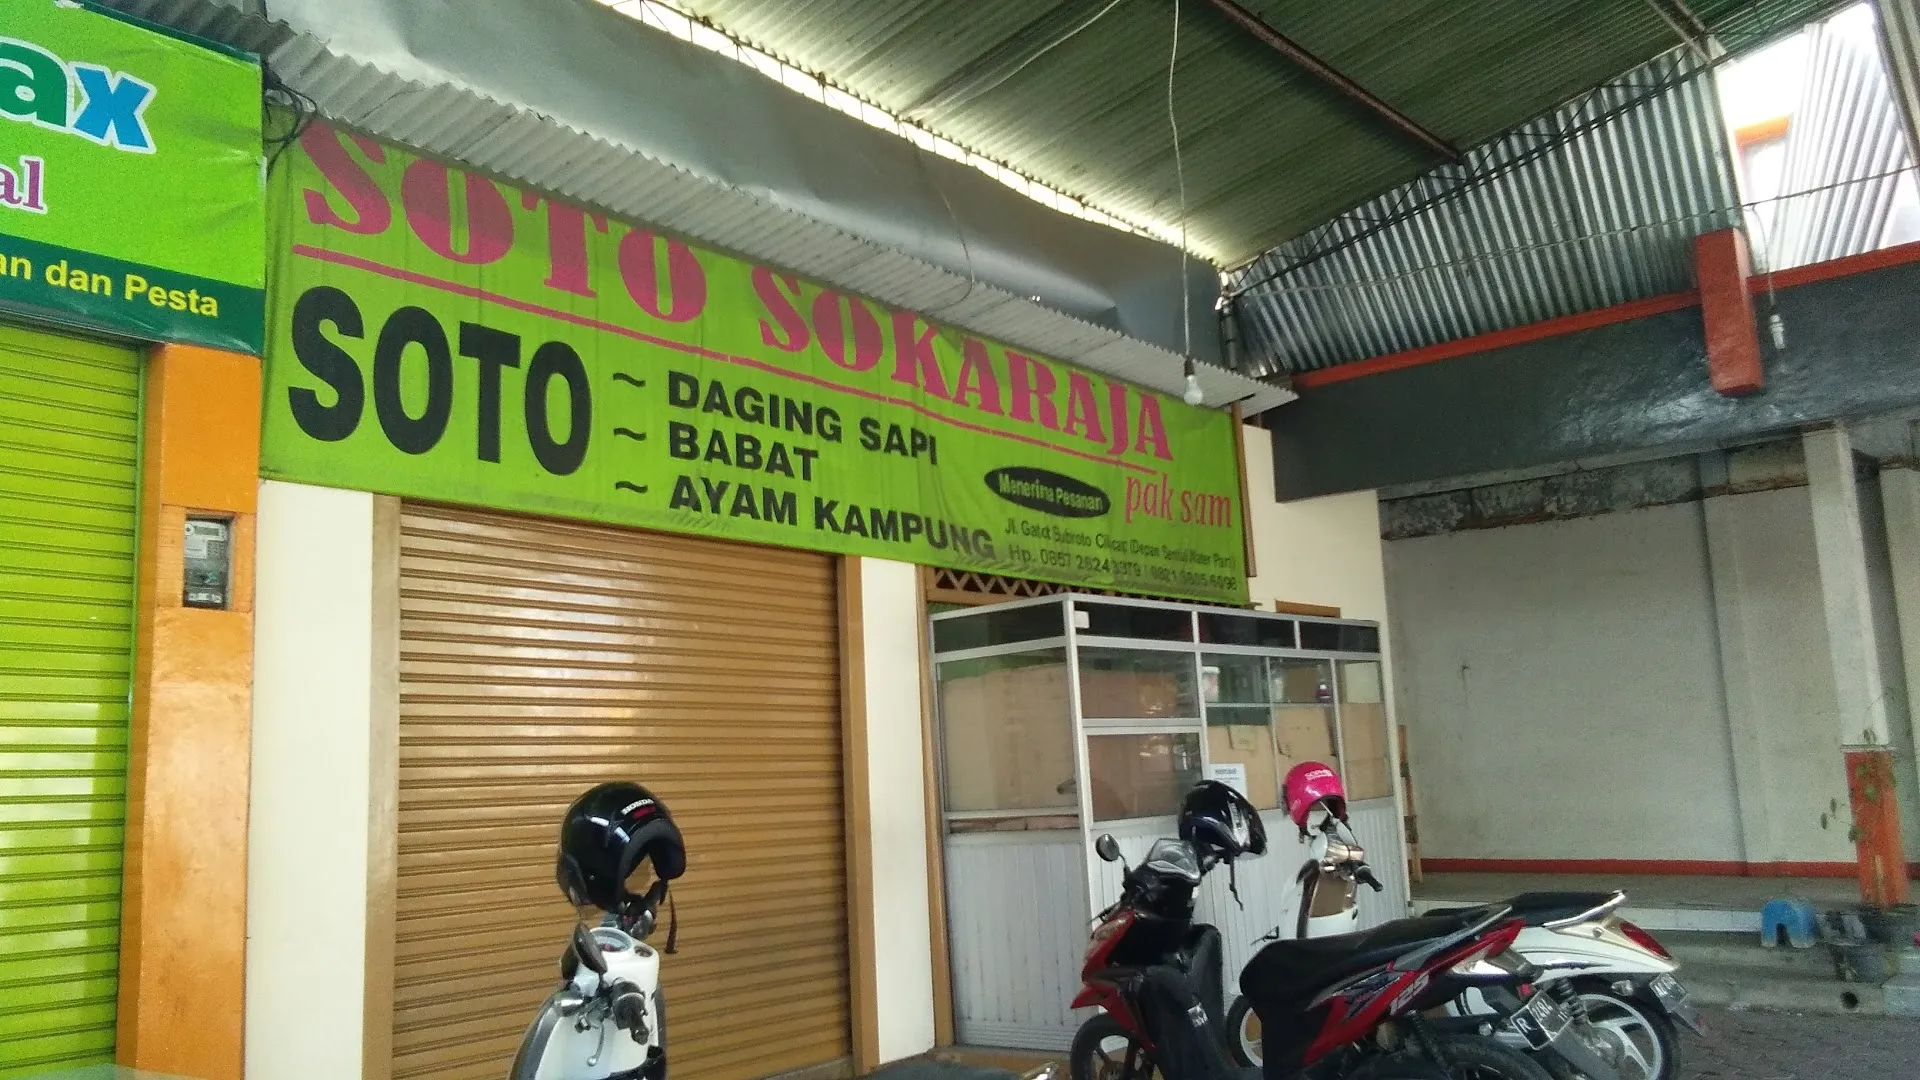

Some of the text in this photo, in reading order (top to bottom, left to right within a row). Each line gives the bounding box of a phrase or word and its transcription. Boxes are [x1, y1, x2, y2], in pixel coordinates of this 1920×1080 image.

[45, 260, 113, 297] dan
[124, 274, 219, 318] Pesta
[300, 120, 1174, 461] SOTO SOKARAJA
[288, 285, 593, 477] SOTO
[668, 370, 938, 466] DAGING SAPI
[669, 420, 819, 482] BABAT
[669, 475, 996, 561] AYAM KAMPUNG
[998, 473, 1104, 511] Menerima Pesanan
[1125, 472, 1232, 528] pak sam
[620, 798, 655, 816] HONDA
[1516, 1017, 1532, 1034] R
